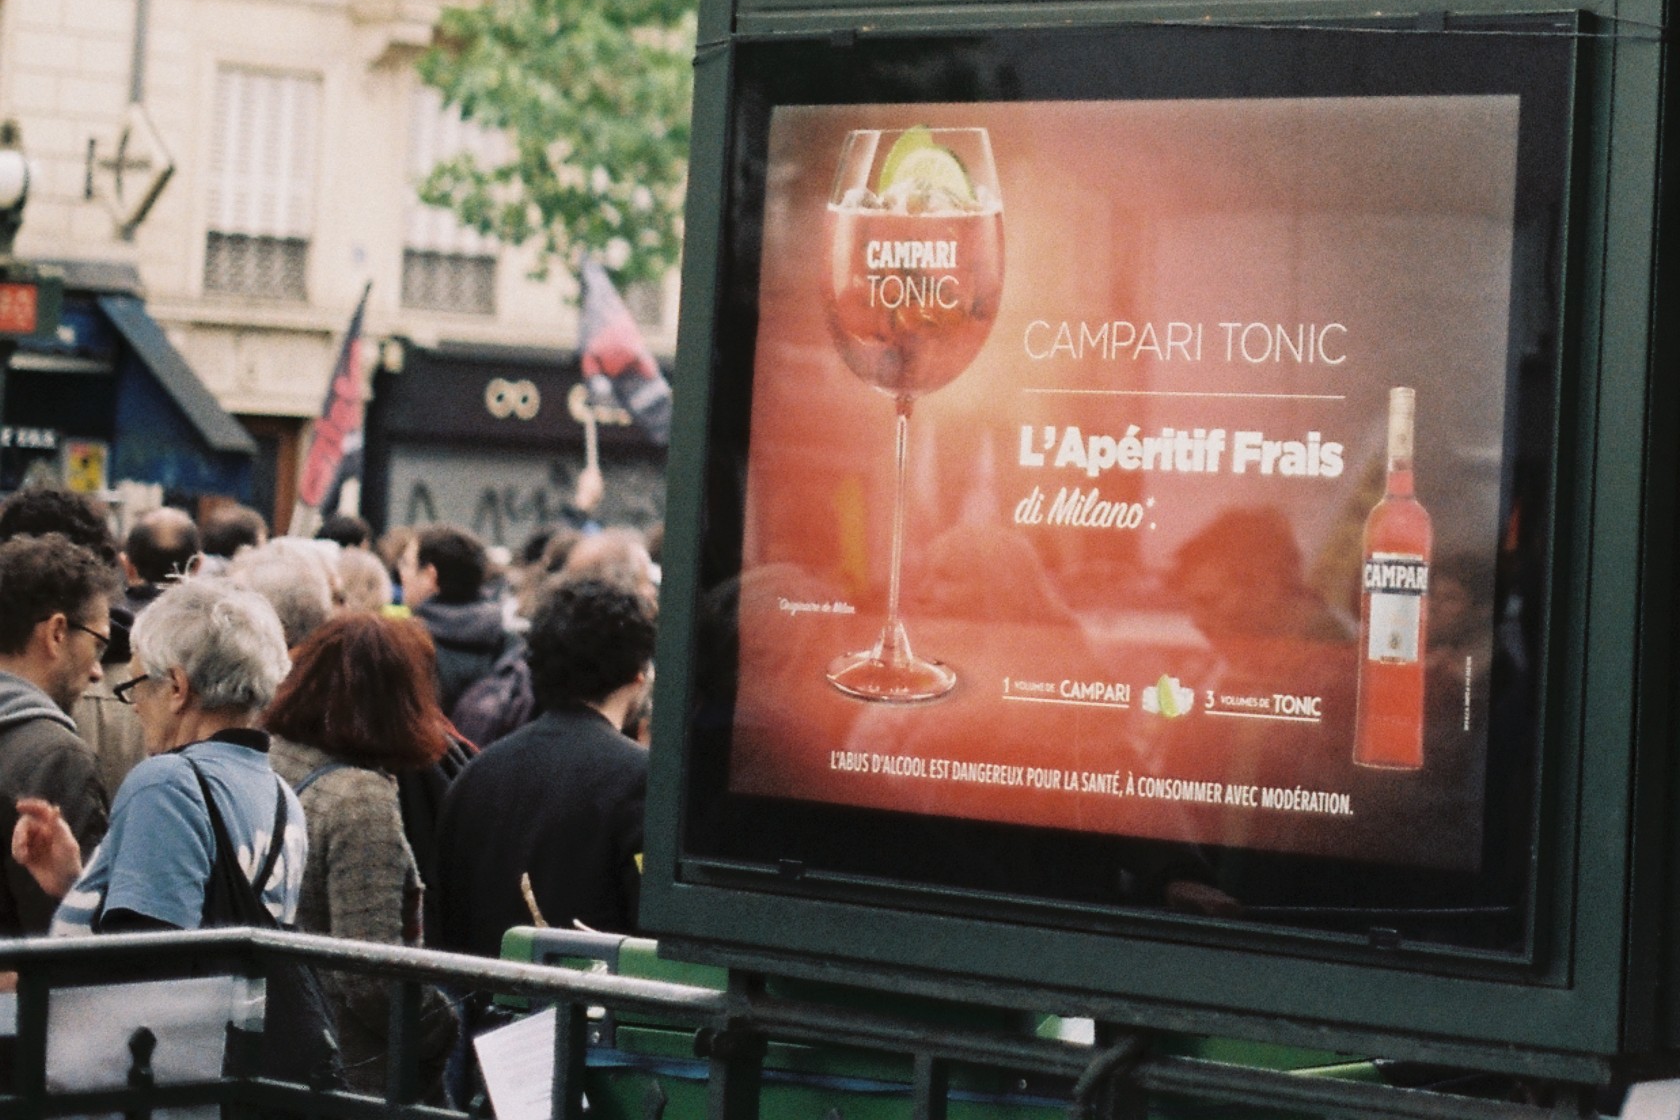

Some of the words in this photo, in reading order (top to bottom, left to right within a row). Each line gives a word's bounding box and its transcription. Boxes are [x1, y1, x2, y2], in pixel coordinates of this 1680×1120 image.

[866, 240, 958, 269] CAMPARI
[866, 275, 960, 309] TONIC
[1023, 319, 1203, 362] CAMPARI
[1218, 321, 1348, 365] TONIC
[1232, 430, 1345, 478] Frais
[1014, 485, 1044, 525] di
[1003, 677, 1010, 693] 1
[1060, 679, 1131, 702] CAMPARI
[1204, 690, 1215, 709] 3
[1220, 695, 1258, 707] VOLUMES
[1272, 694, 1322, 716] TONIC
[830, 750, 869, 772] L'ABUS
[871, 753, 928, 778] D'ALCOOL
[929, 758, 951, 780] EST
[952, 760, 1024, 786] DANGEREUX
[1026, 767, 1062, 790] POUR
[1063, 770, 1080, 792] LA
[1081, 770, 1123, 798] SANTÉ,
[1125, 770, 1135, 796] À
[1137, 775, 1222, 804] CONSOMMER
[1224, 784, 1259, 807] AVEC
[1261, 784, 1354, 816] MODÉRATION.
